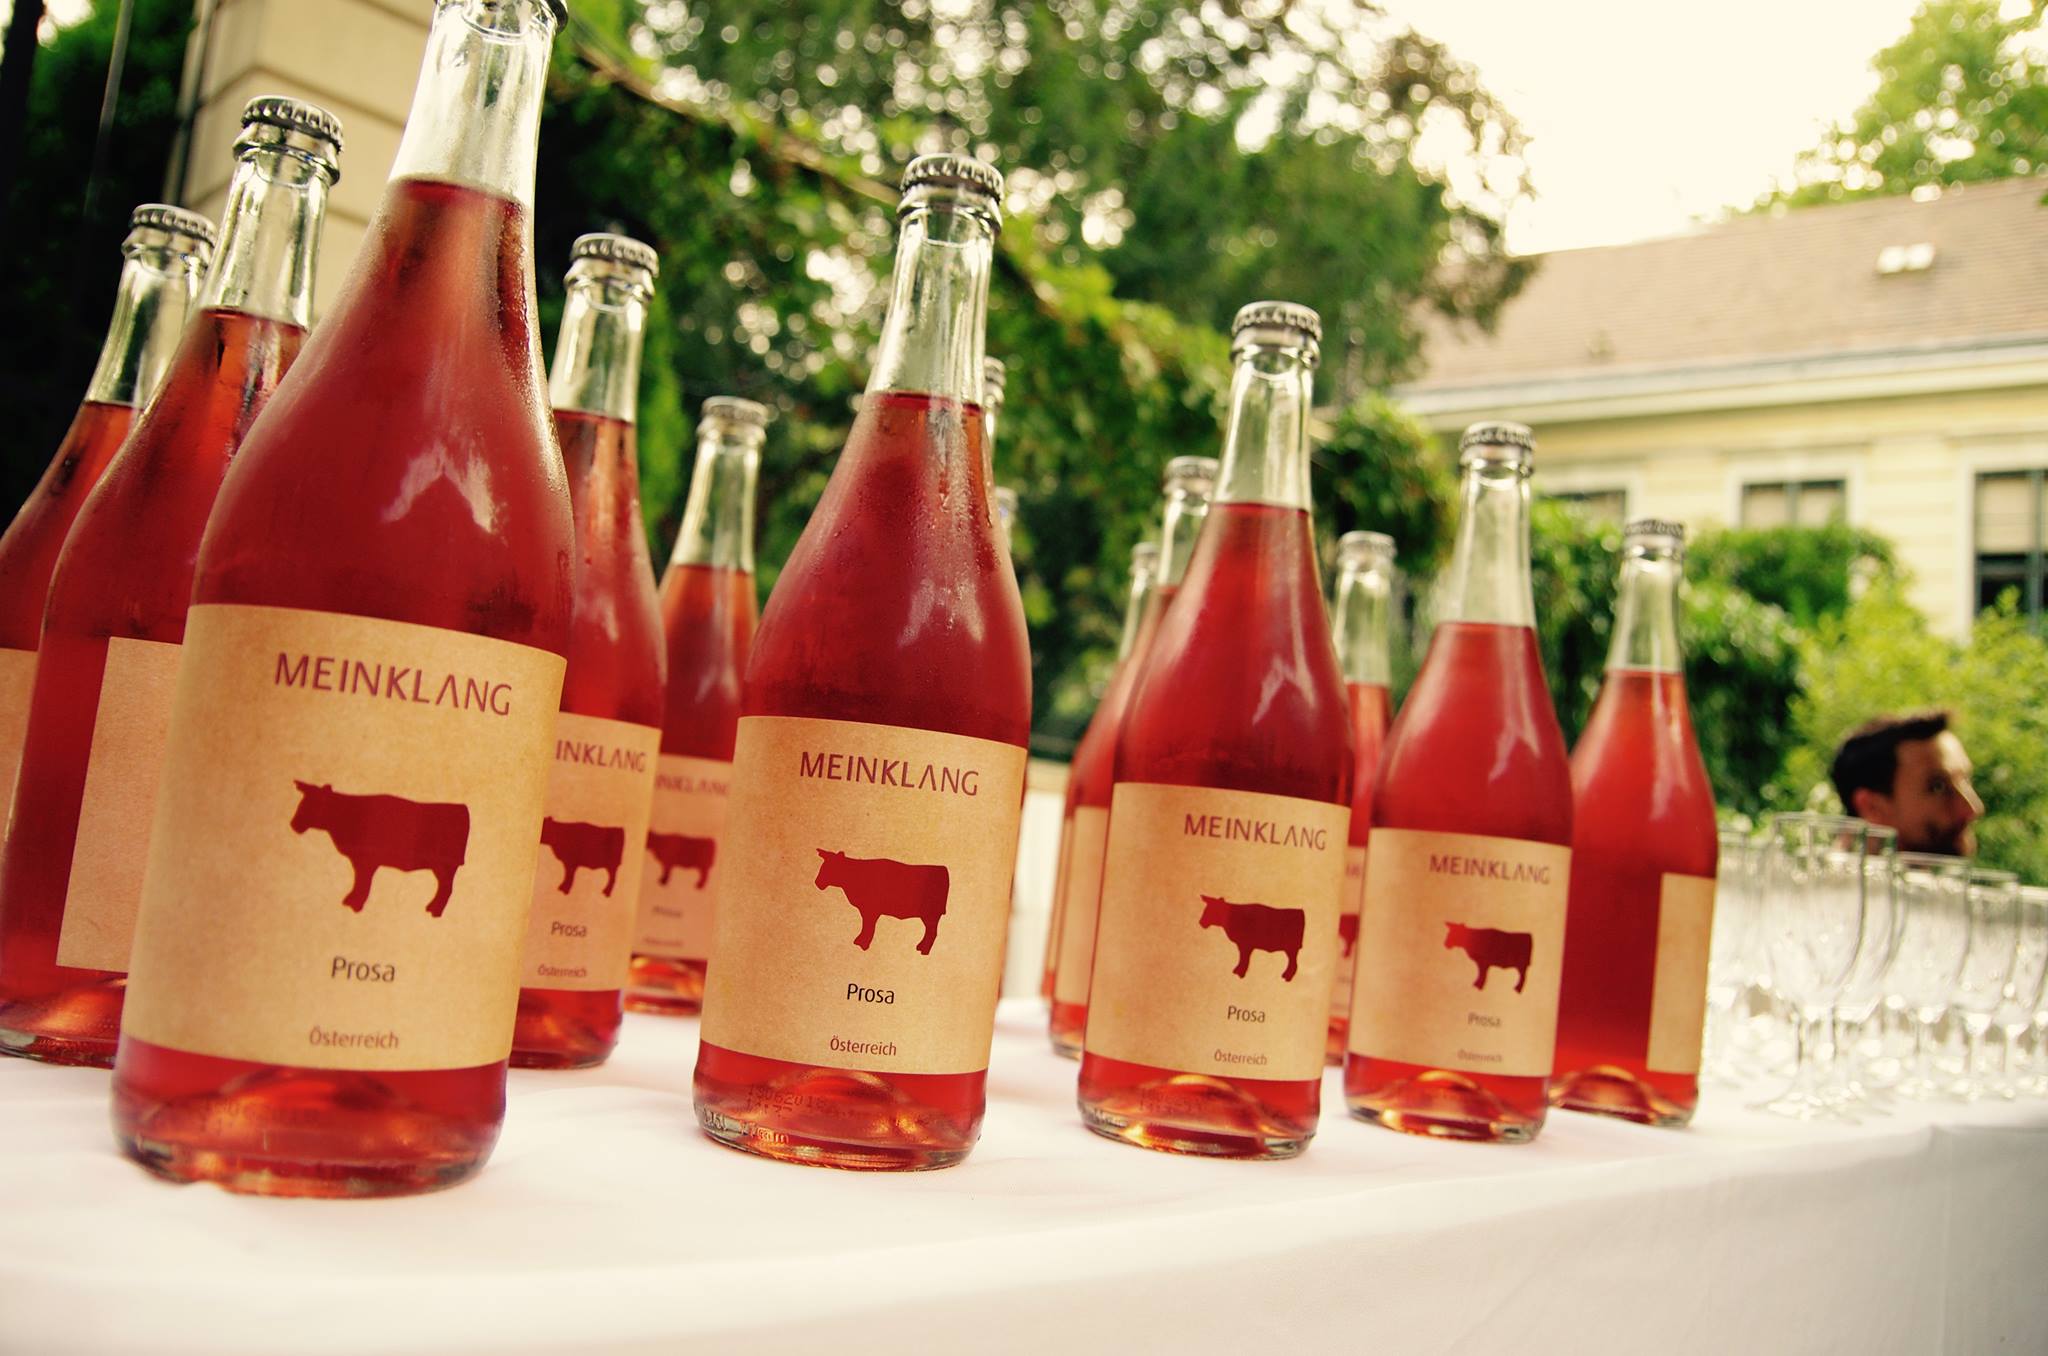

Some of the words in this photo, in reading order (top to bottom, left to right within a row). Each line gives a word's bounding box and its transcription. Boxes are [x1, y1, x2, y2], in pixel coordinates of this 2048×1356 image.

[274, 652, 512, 716] MEINKLANG
[800, 751, 979, 796] MEINKLANG
[1184, 813, 1327, 851] MEINKLANG
[1429, 855, 1549, 885] MEINKLANG
[551, 921, 587, 938] Prosa
[331, 955, 395, 983] Prosa
[846, 983, 895, 1004] Prosa
[1227, 1005, 1266, 1024] Prosa
[309, 1025, 399, 1049] Österreich
[830, 1034, 897, 1056] Österreich
[1214, 1048, 1268, 1066] Österreich
